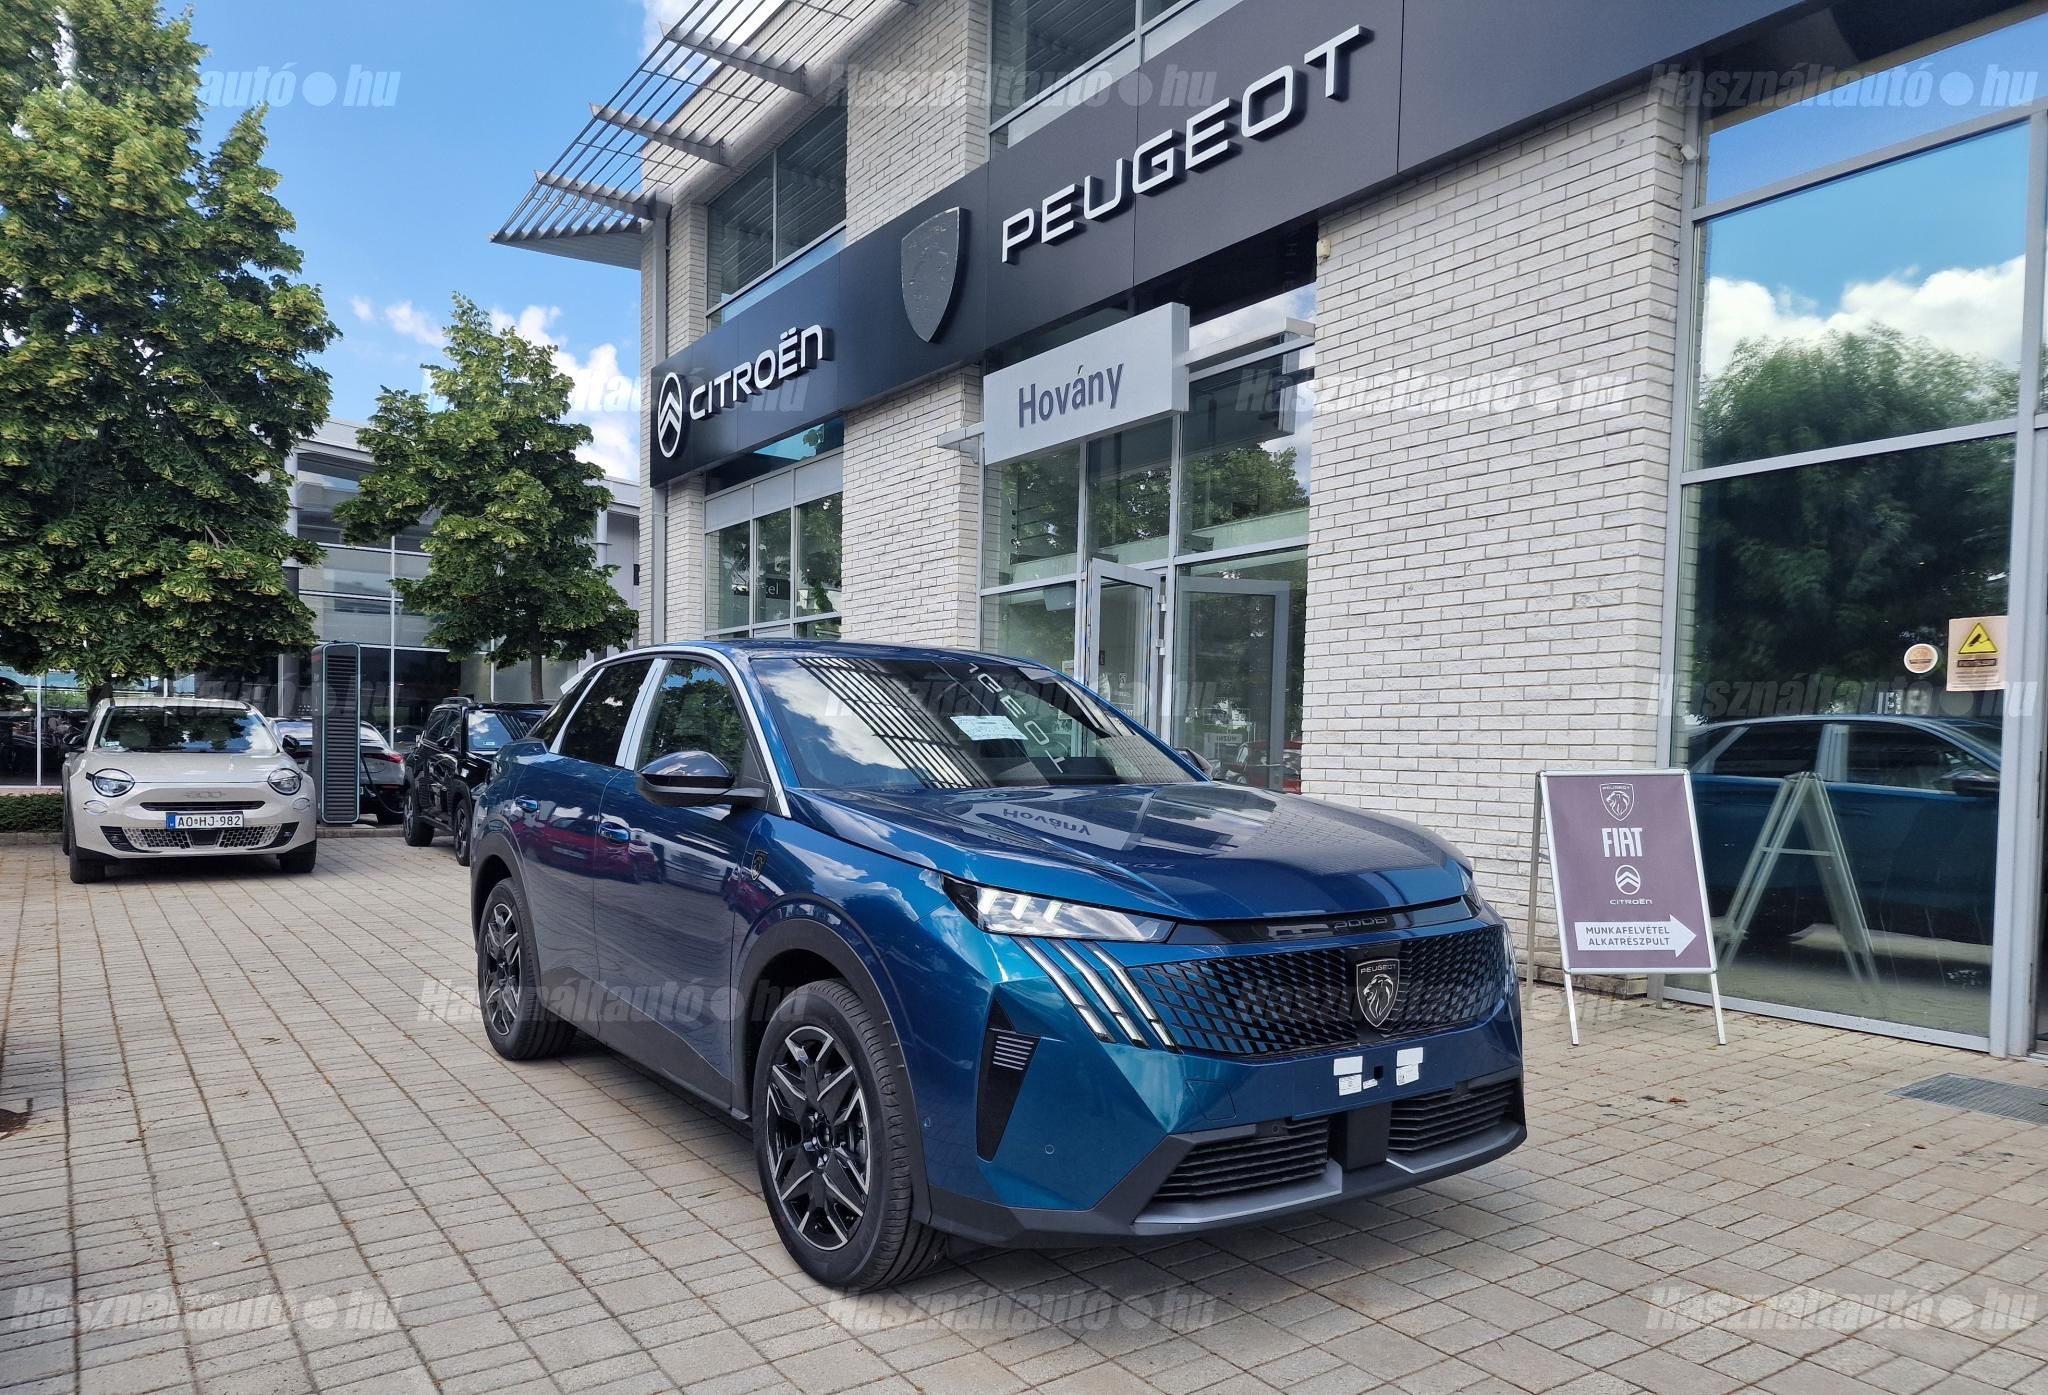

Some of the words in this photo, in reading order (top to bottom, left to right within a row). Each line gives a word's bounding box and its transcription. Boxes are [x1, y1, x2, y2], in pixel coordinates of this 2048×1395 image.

[1002, 24, 1363, 263] PEUGEOT
[1018, 363, 1124, 428] Hovány
[1601, 827, 1643, 858] FIAT
[1585, 925, 1670, 935] MUNKAFELVÉTEL
[1588, 936, 1670, 946] ALKATRÉSZPULT
[1360, 963, 1396, 975] PEUGEOT
